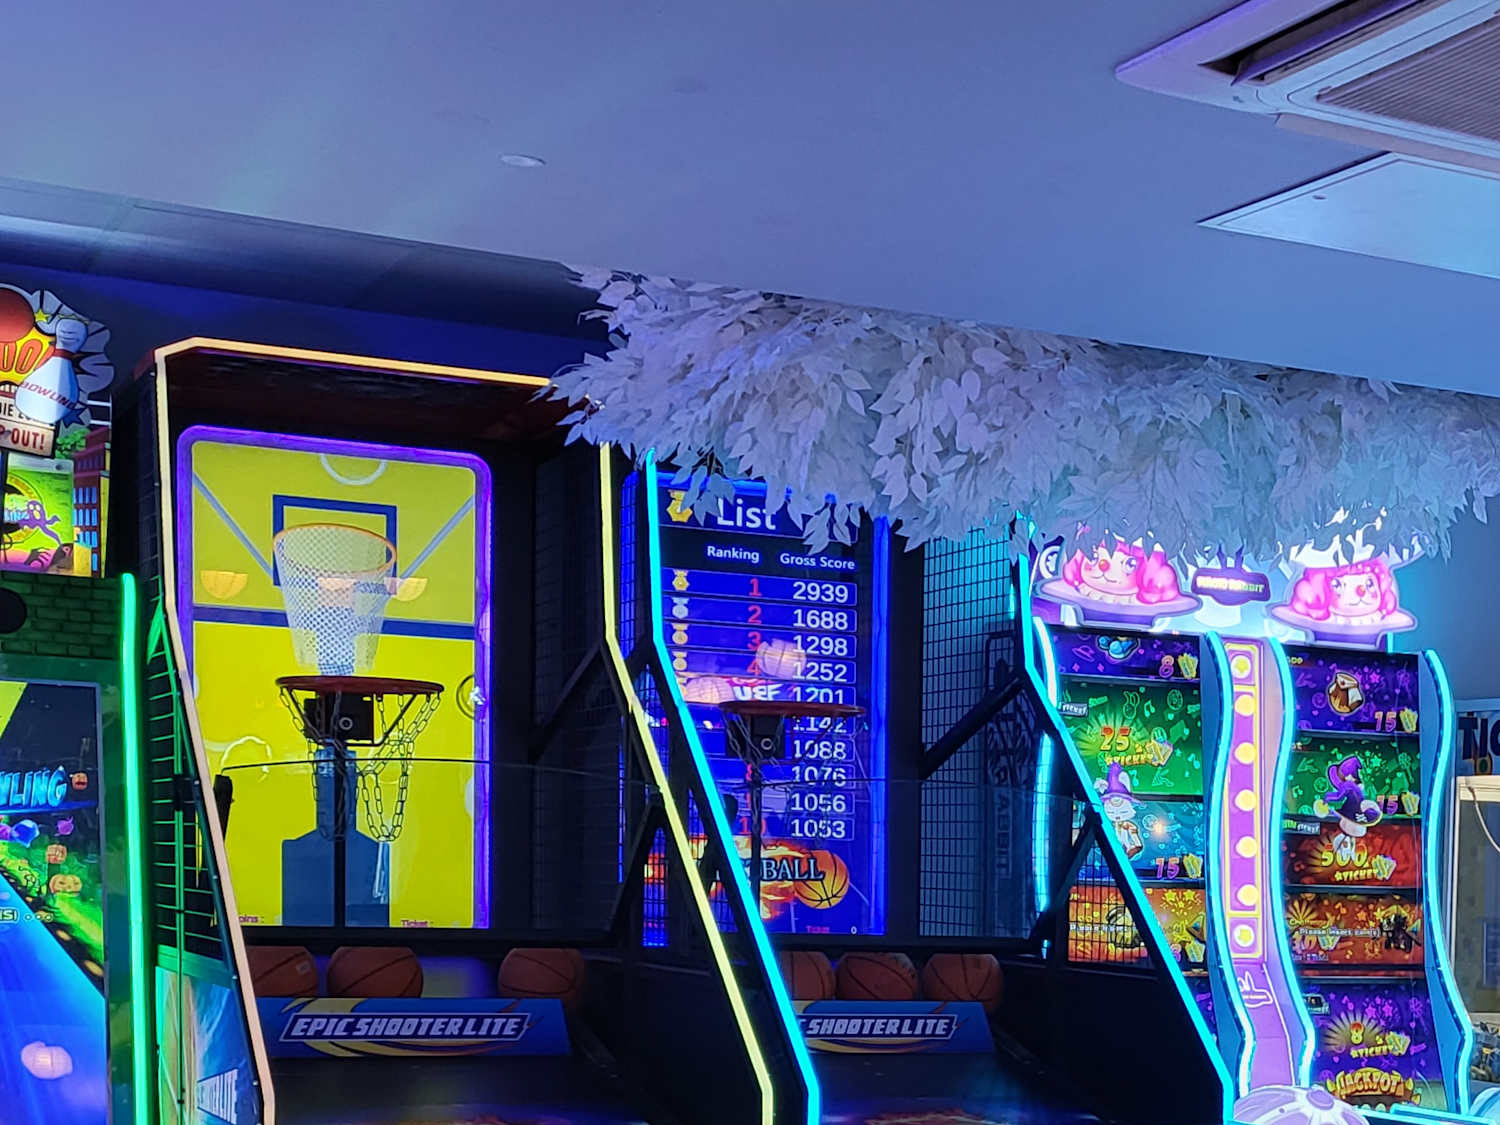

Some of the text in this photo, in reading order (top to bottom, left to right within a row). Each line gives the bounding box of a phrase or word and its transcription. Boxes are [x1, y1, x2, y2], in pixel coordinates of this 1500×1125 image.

[11, 427, 46, 450] OUT!
[717, 498, 777, 530] List
[707, 545, 760, 564] Ranking
[780, 552, 856, 570] Gross Score
[749, 578, 849, 604] 1 2939
[748, 605, 849, 631] 2 1688
[792, 634, 849, 657] 1298
[791, 661, 848, 683] 1252
[792, 686, 844, 704] 1201
[1100, 726, 1131, 751] 25
[791, 792, 846, 813] 1056
[791, 818, 845, 838] 1053
[761, 858, 826, 881] BALL
[290, 1016, 351, 1037] EPIC
[1350, 1022, 1365, 1044] 8
[1338, 1069, 1404, 1098] JACKPOT
